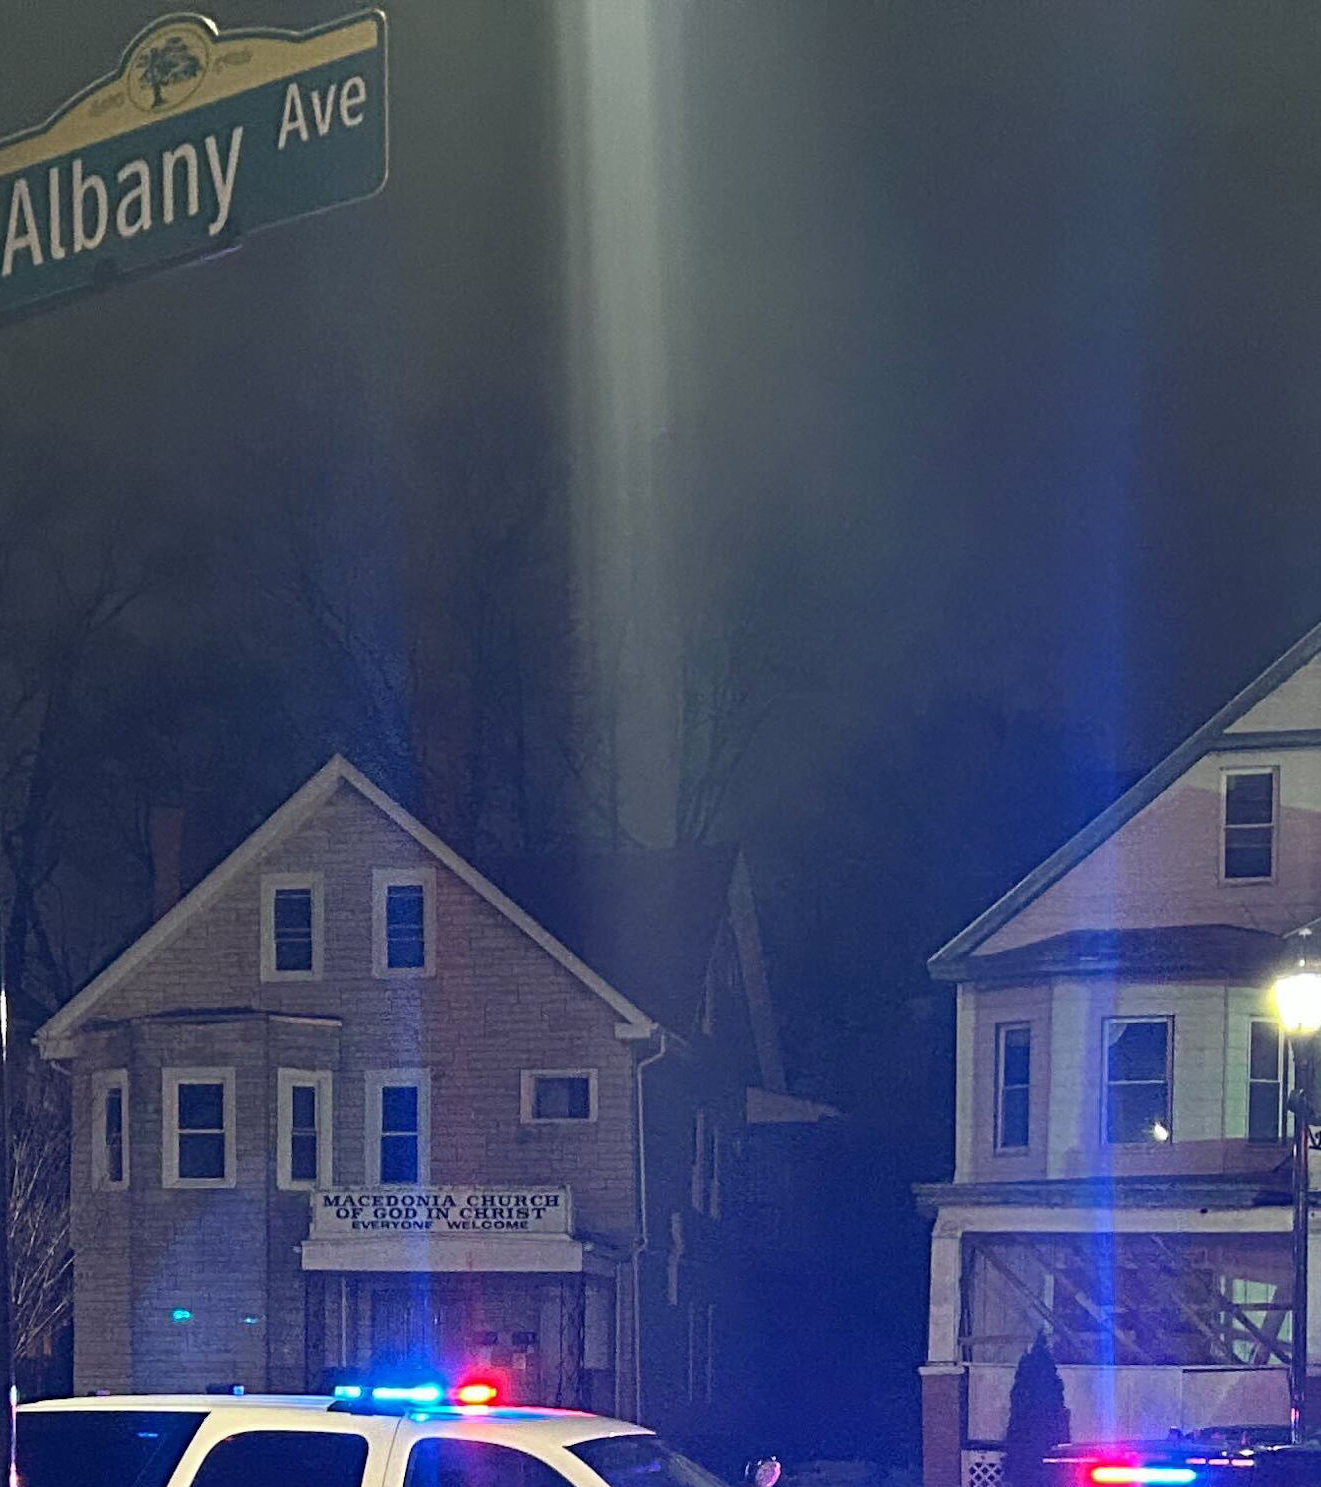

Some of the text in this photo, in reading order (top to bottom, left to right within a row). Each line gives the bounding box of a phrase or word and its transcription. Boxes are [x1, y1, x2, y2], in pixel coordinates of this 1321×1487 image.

[1, 75, 366, 277] Albany Ave
[323, 1195, 560, 1207] MACEDONIA CHURCH
[336, 1207, 547, 1220] OF GOD IN CHRIST
[352, 1221, 529, 1230] EVERYONE WELCOME
